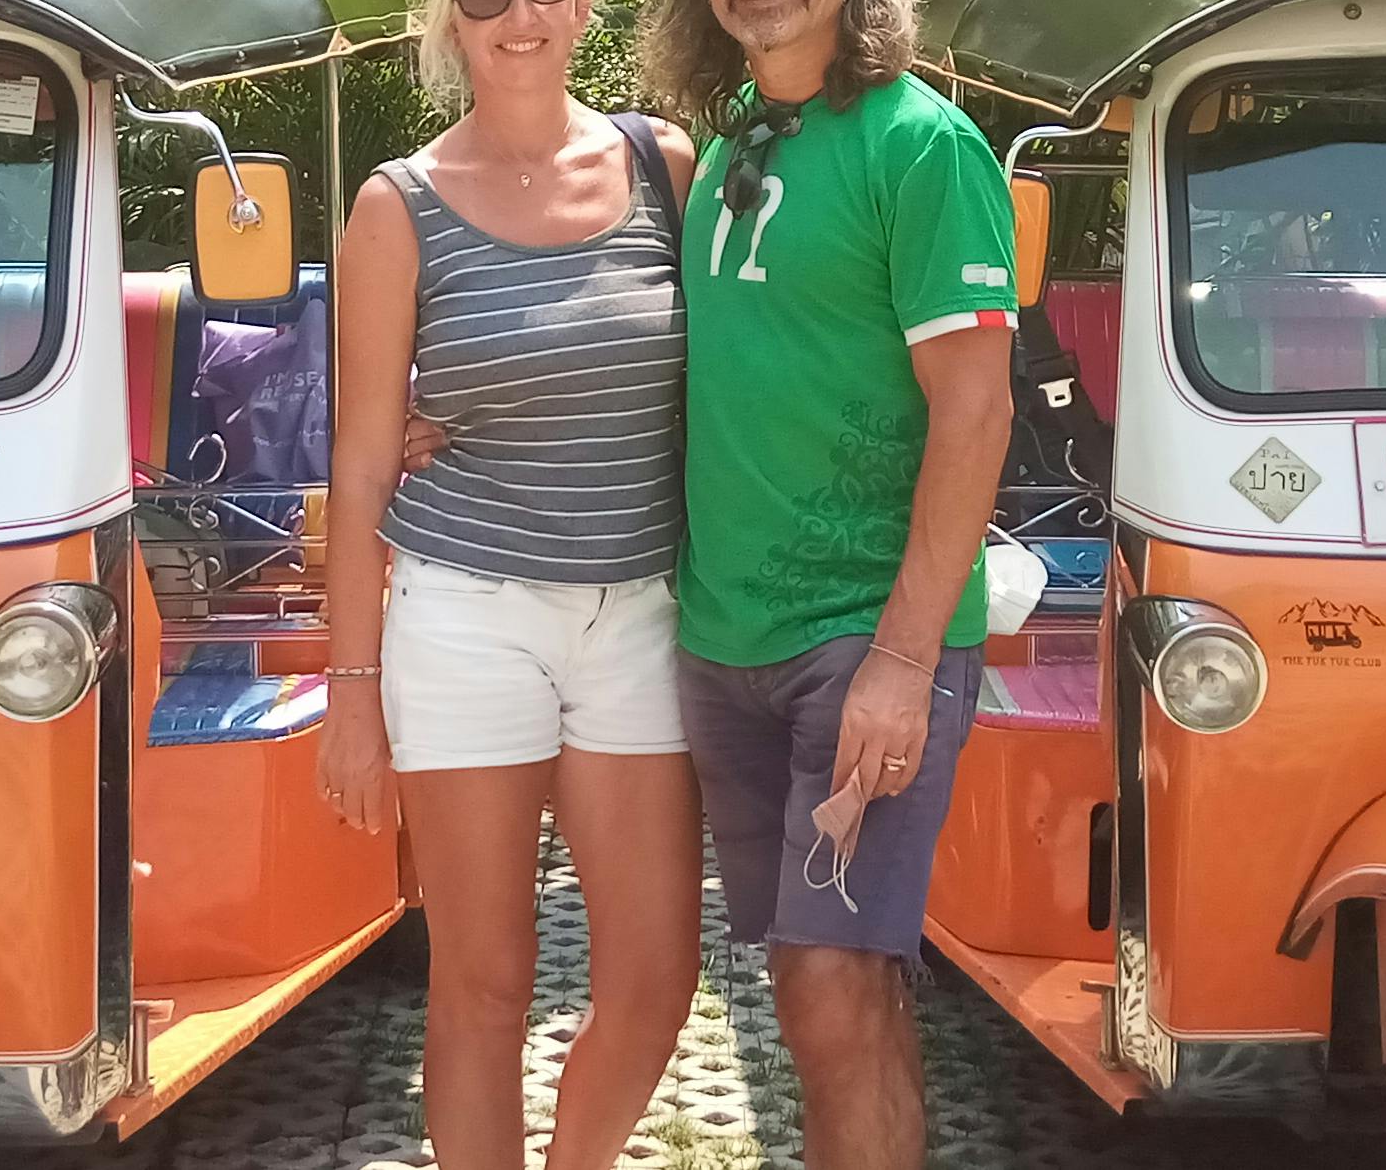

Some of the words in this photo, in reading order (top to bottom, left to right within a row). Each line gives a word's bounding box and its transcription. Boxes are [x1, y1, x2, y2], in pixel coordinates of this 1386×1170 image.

[1248, 463, 1306, 493] ปาย
[1282, 656, 1303, 666] THE
[1306, 656, 1327, 666] TUK
[1330, 657, 1351, 667] TUK
[1353, 657, 1382, 668] CLUB
